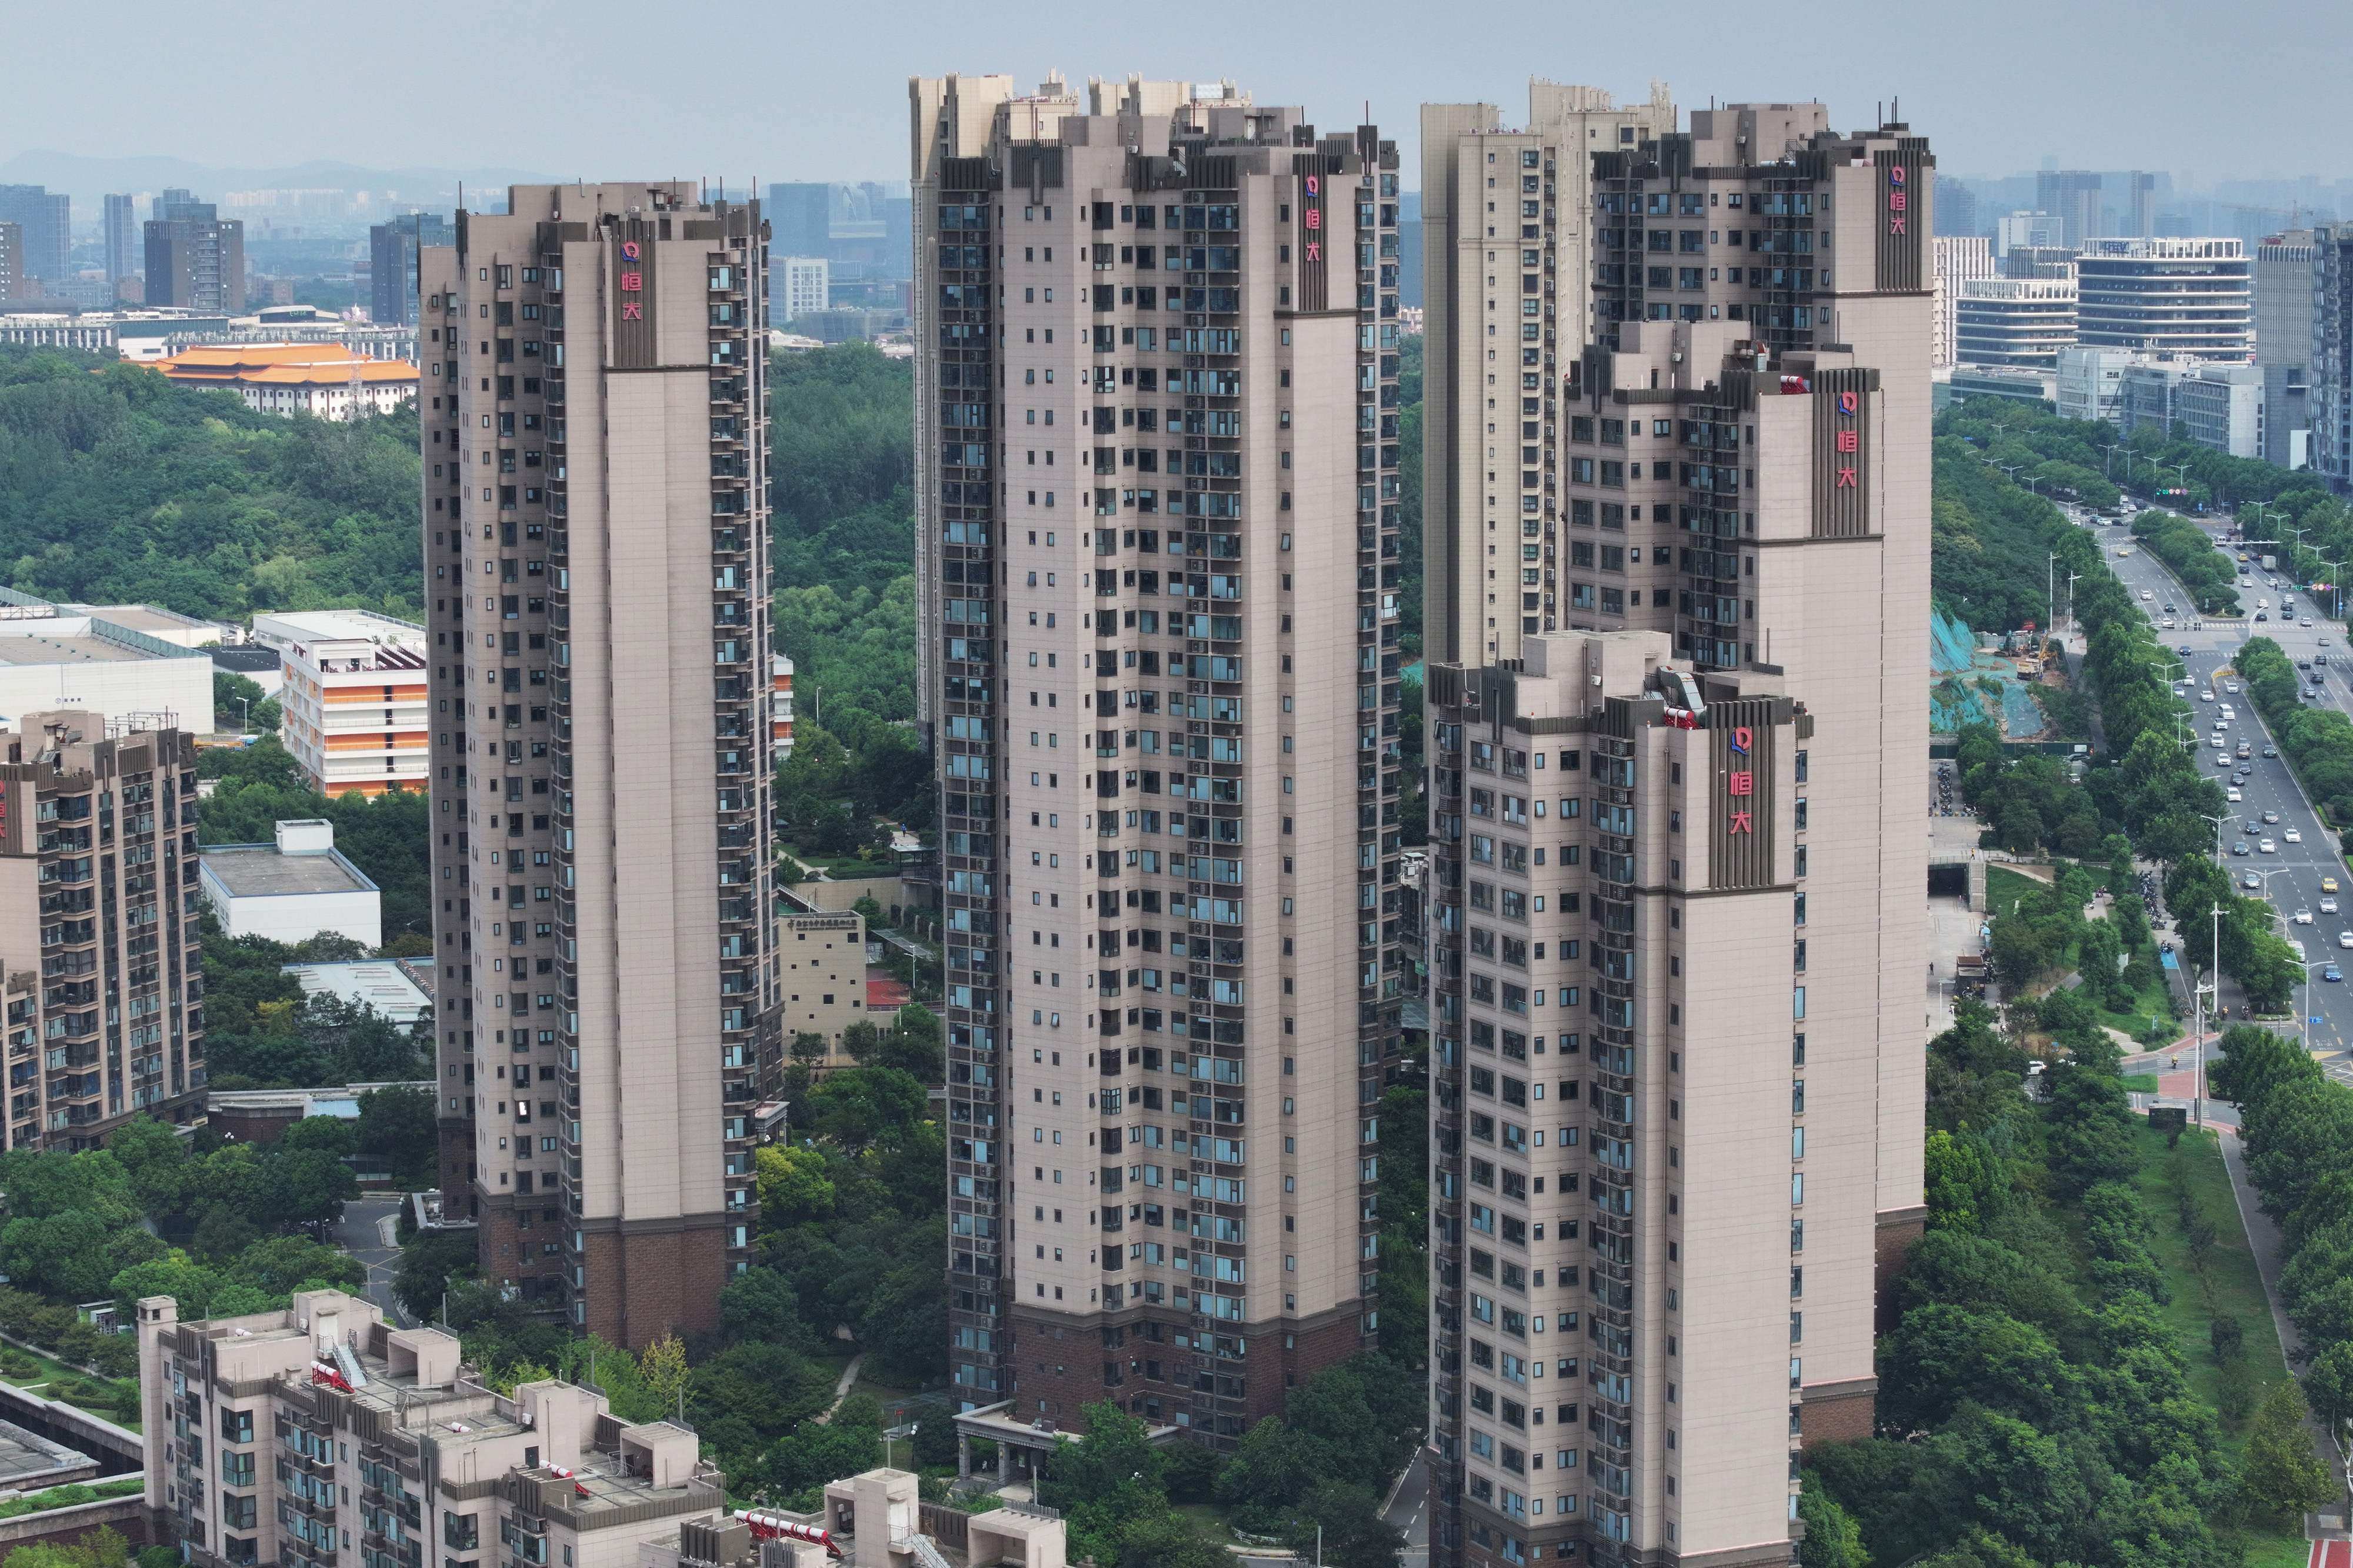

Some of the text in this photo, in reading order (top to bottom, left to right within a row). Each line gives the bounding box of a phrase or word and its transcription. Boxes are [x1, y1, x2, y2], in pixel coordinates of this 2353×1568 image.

[1306, 209, 1320, 261] 恒大
[1891, 194, 1905, 234] 恒大
[622, 273, 642, 321] 恒大
[1838, 431, 1857, 488] 恒大
[1731, 772, 1752, 835] 恒大
